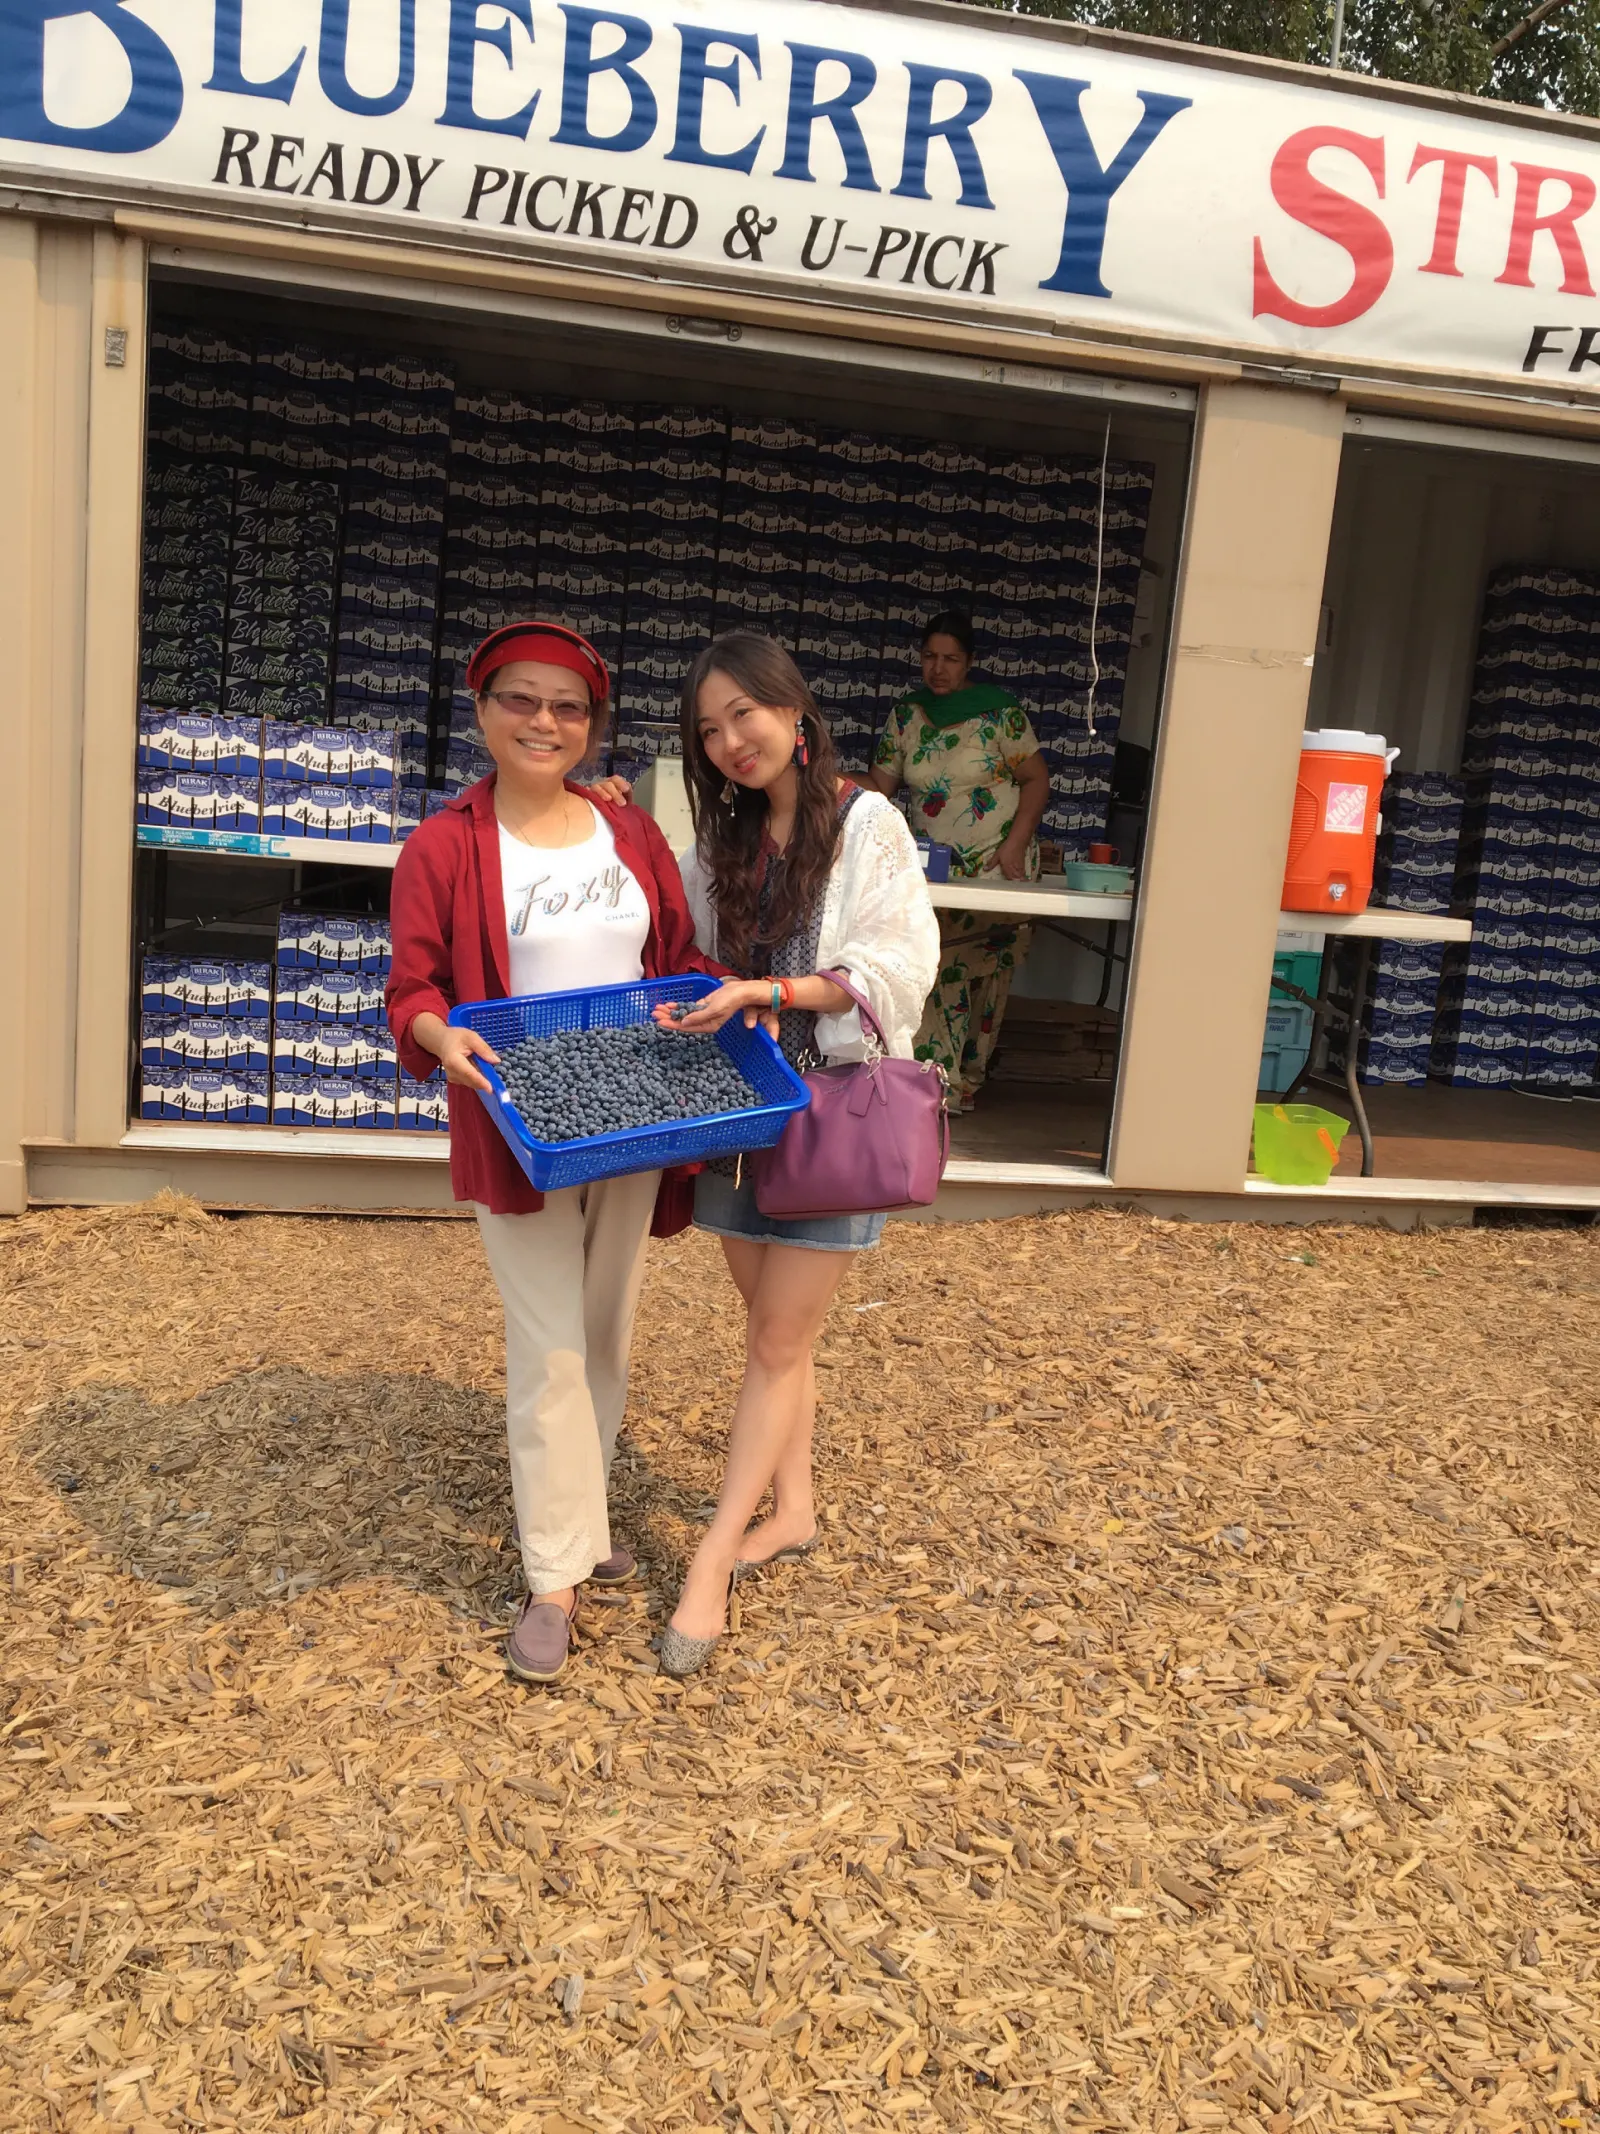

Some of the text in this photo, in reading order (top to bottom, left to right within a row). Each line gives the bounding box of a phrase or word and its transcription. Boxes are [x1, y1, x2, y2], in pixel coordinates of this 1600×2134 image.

[0, 0, 1598, 328] BLUEBERRY STR
[212, 126, 1009, 296] READY PICKED & U-PICK
[382, 371, 445, 387] Blueberries
[378, 416, 441, 432] Blueberries
[375, 461, 437, 477] Blueberries
[240, 480, 314, 511] Blueberries
[373, 505, 435, 520] Blueberries
[238, 515, 302, 542] Bleuets
[236, 550, 300, 577] Bleuets
[368, 548, 431, 563] Blueberries
[234, 584, 298, 610] Bleuets
[363, 591, 425, 607] Blueberries
[232, 619, 295, 645] Bleuets
[361, 634, 423, 650] Blueberries
[230, 653, 304, 681] Blueberries
[360, 676, 421, 692] Blueberries
[228, 687, 300, 715] Blueberries
[181, 719, 208, 729] BIRAK
[317, 733, 343, 742] BIRAK
[159, 738, 246, 757] Blueberries
[1056, 739, 1106, 755] Blueberries
[295, 752, 379, 771] Blueberries
[181, 777, 208, 787] BIRAK
[1051, 778, 1101, 794] Blueberries
[315, 790, 341, 799] BIRAK
[1413, 793, 1451, 804] Blueberries
[159, 797, 245, 816] Blueberries
[294, 808, 378, 827] Blueberries
[1047, 814, 1096, 829] Blueberries
[1408, 829, 1446, 841] Blueberries
[1404, 864, 1442, 876] Blueberries
[1401, 900, 1438, 911] Blueberries
[605, 912, 640, 922] CHANEL
[328, 923, 353, 931] BIRAK
[308, 941, 388, 958] Blueberries
[194, 967, 220, 976] BIRAK
[1391, 968, 1428, 979] Blueberries
[326, 976, 351, 984] BIRAK
[173, 986, 256, 1003] Blueberries
[306, 994, 384, 1011] Blueberries
[1387, 1002, 1423, 1013] Blueberries
[193, 1022, 219, 1030] BIRAK
[325, 1030, 350, 1038] BIRAK
[173, 1040, 255, 1056] Blueberries
[1383, 1037, 1420, 1047] Blueberries
[304, 1049, 384, 1065] Blueberries
[194, 1076, 220, 1084] BIRAK
[1378, 1070, 1415, 1081] Blueberries
[323, 1083, 349, 1091] BIRAK
[172, 1094, 254, 1110] Blueberries
[303, 1101, 383, 1117] Blueberries
